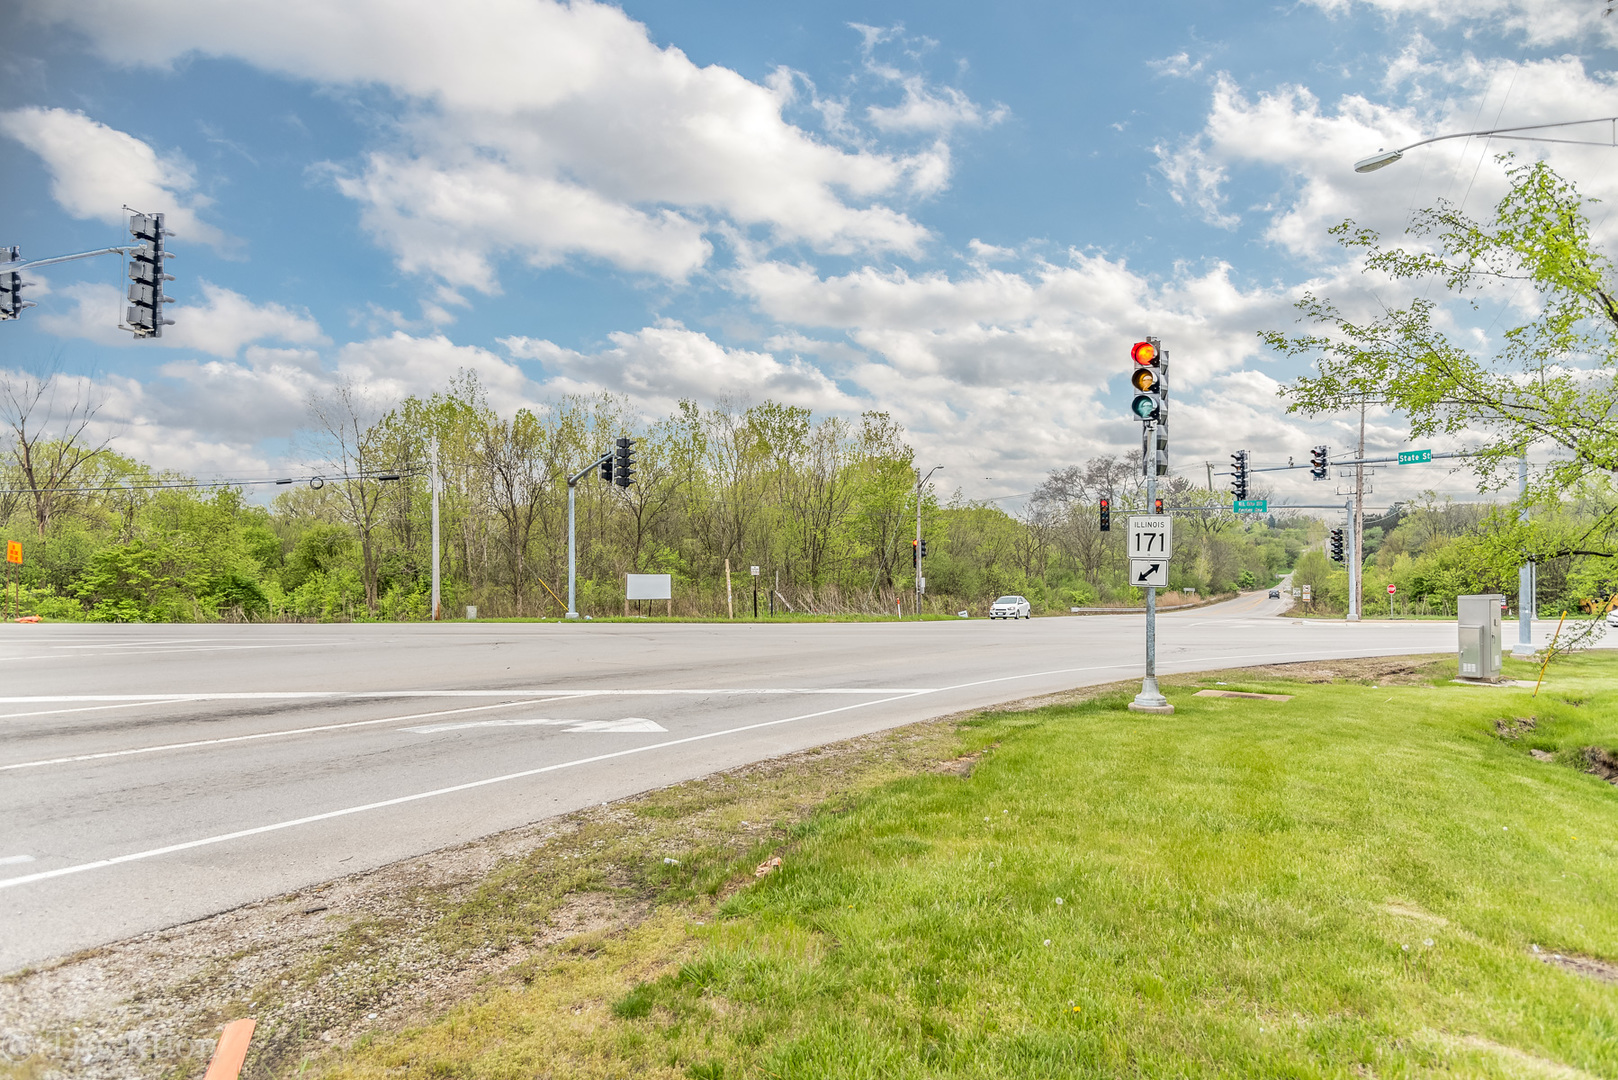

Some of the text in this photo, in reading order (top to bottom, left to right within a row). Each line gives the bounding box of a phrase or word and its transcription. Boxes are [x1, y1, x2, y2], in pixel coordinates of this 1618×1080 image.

[1400, 452, 1430, 462] State St
[1135, 532, 1164, 552] 171
